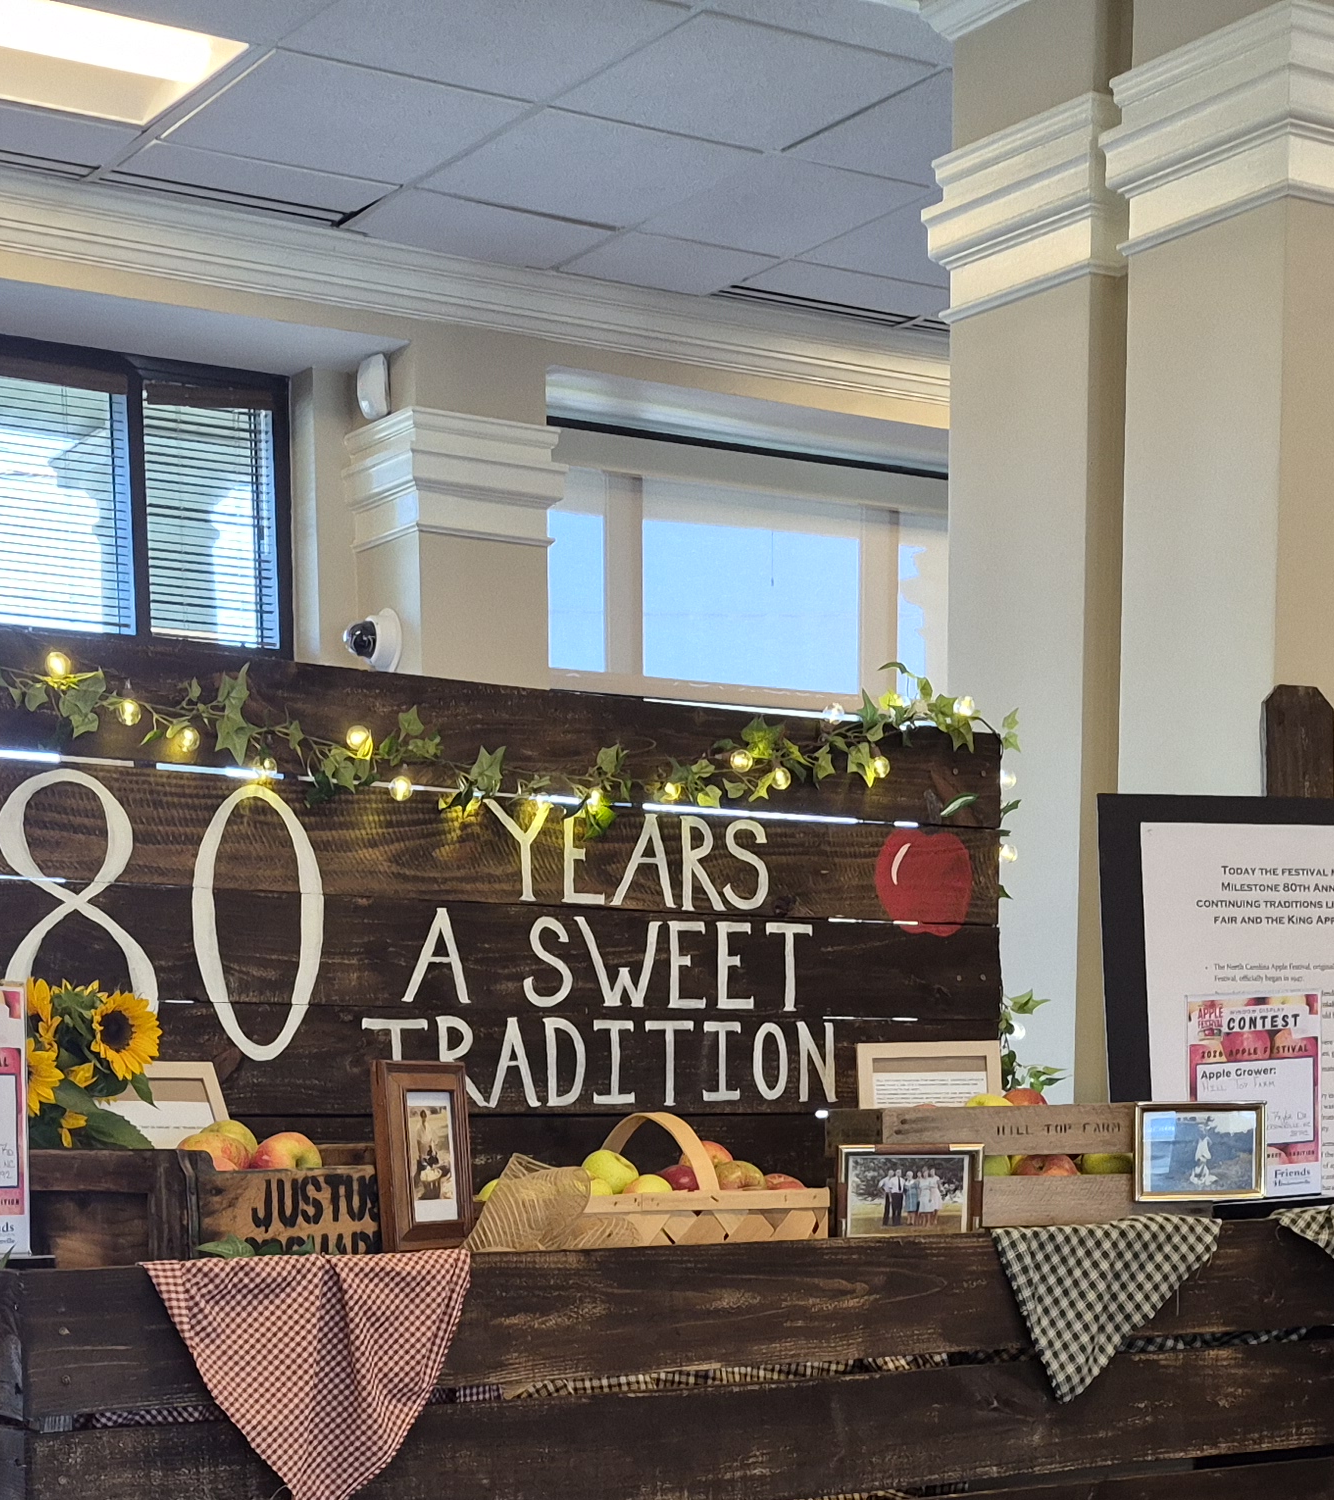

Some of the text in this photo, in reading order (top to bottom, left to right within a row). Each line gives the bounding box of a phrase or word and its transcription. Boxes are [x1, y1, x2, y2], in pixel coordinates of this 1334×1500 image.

[484, 797, 769, 912] YEARS
[401, 907, 813, 1012] A SWEET
[1197, 1006, 1223, 1019] APPLE
[1227, 1013, 1300, 1031] CONTEST
[1228, 1047, 1258, 1058] APPLE
[1263, 1044, 1309, 1056] FESTIVAL
[361, 1015, 839, 1109] TRADITION
[1201, 1066, 1277, 1081] Apple Grower:
[996, 1122, 1121, 1136] HILL TOP FARM
[1274, 1167, 1311, 1179] Friends
[251, 1173, 380, 1232] JUSTUS
